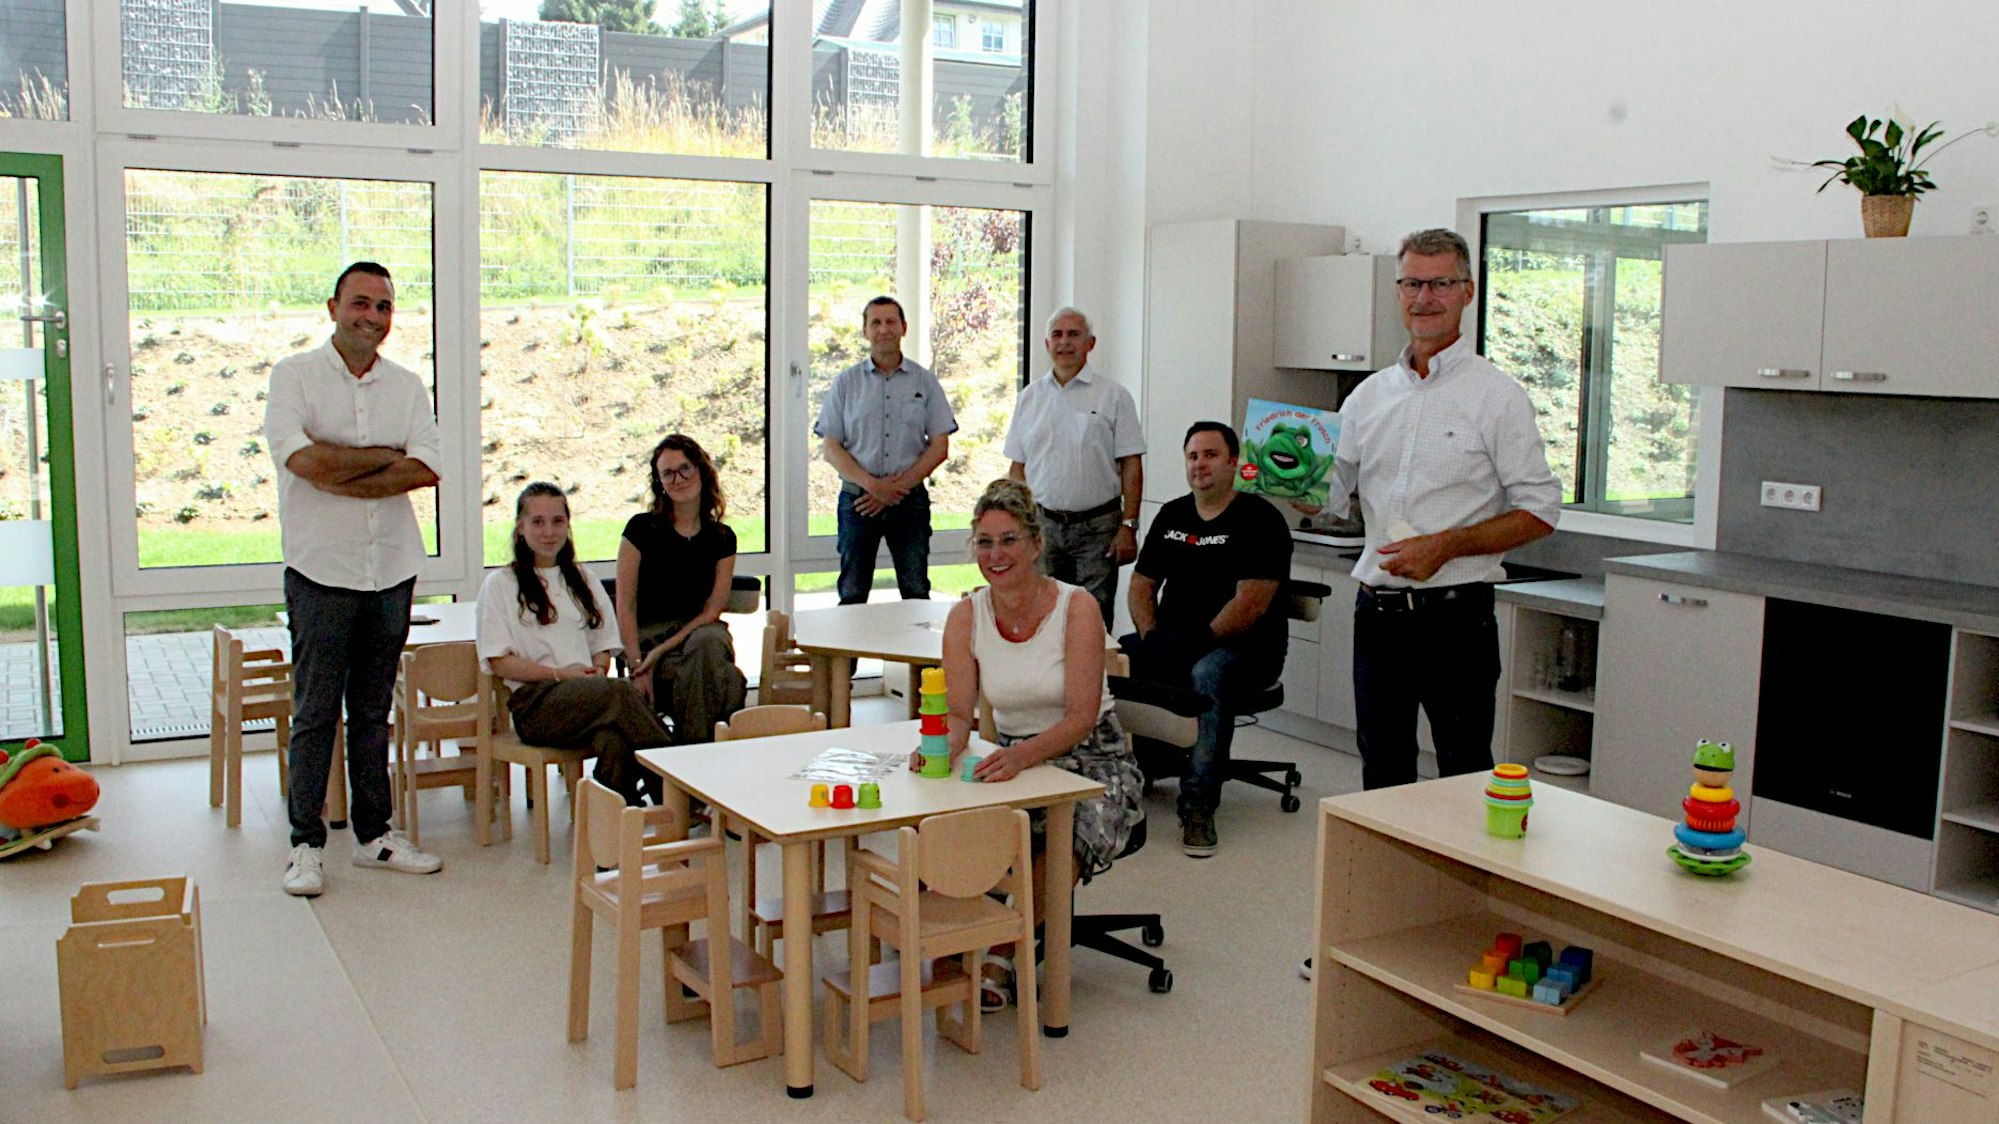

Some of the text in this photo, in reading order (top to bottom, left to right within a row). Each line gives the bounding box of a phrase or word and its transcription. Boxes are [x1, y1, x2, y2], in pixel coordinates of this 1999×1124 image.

[1255, 409, 1292, 432] Friedrich
[1295, 411, 1311, 420] der
[1164, 529, 1227, 546] JACK JONES
